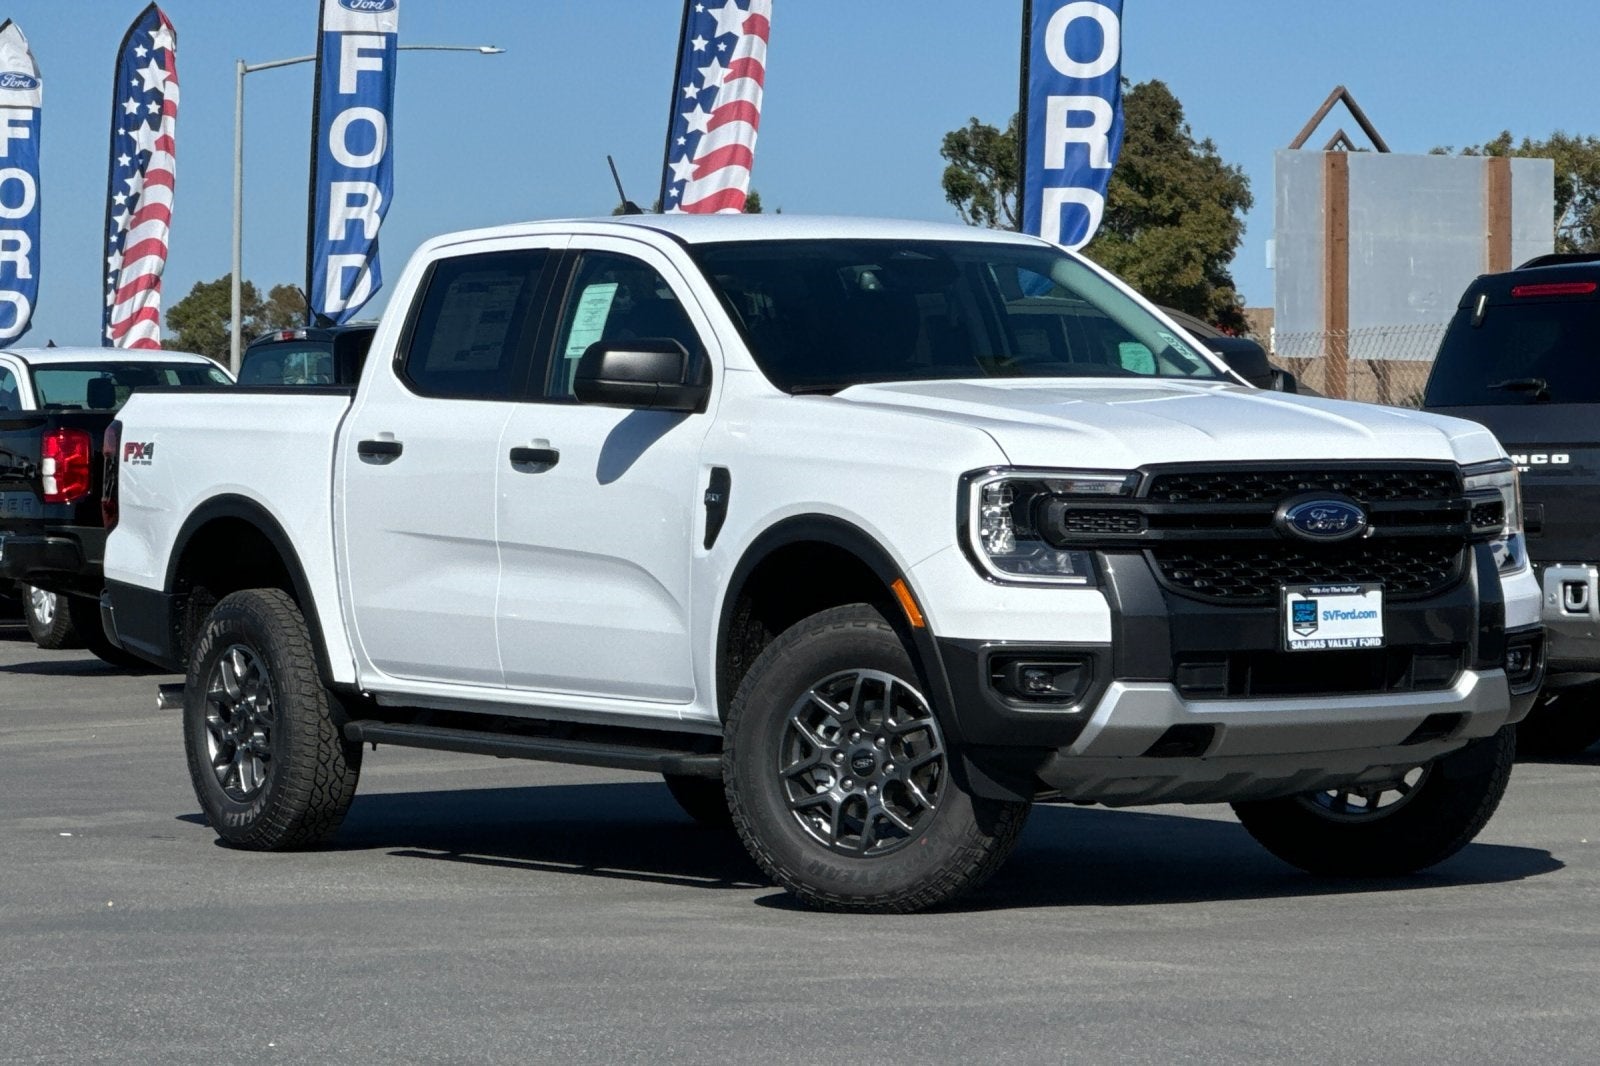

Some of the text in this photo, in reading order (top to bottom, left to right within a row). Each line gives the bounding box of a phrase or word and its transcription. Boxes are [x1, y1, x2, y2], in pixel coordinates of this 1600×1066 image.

[1, 74, 31, 87] Ford
[324, 35, 389, 313] FORD
[0, 108, 36, 338] FORD
[123, 442, 154, 462] FX4
[1510, 454, 1570, 464] NCO
[1307, 508, 1349, 530] Ford
[1322, 609, 1378, 621] SVFord.com
[1291, 637, 1382, 650] SALINAS VALLEY FORD
